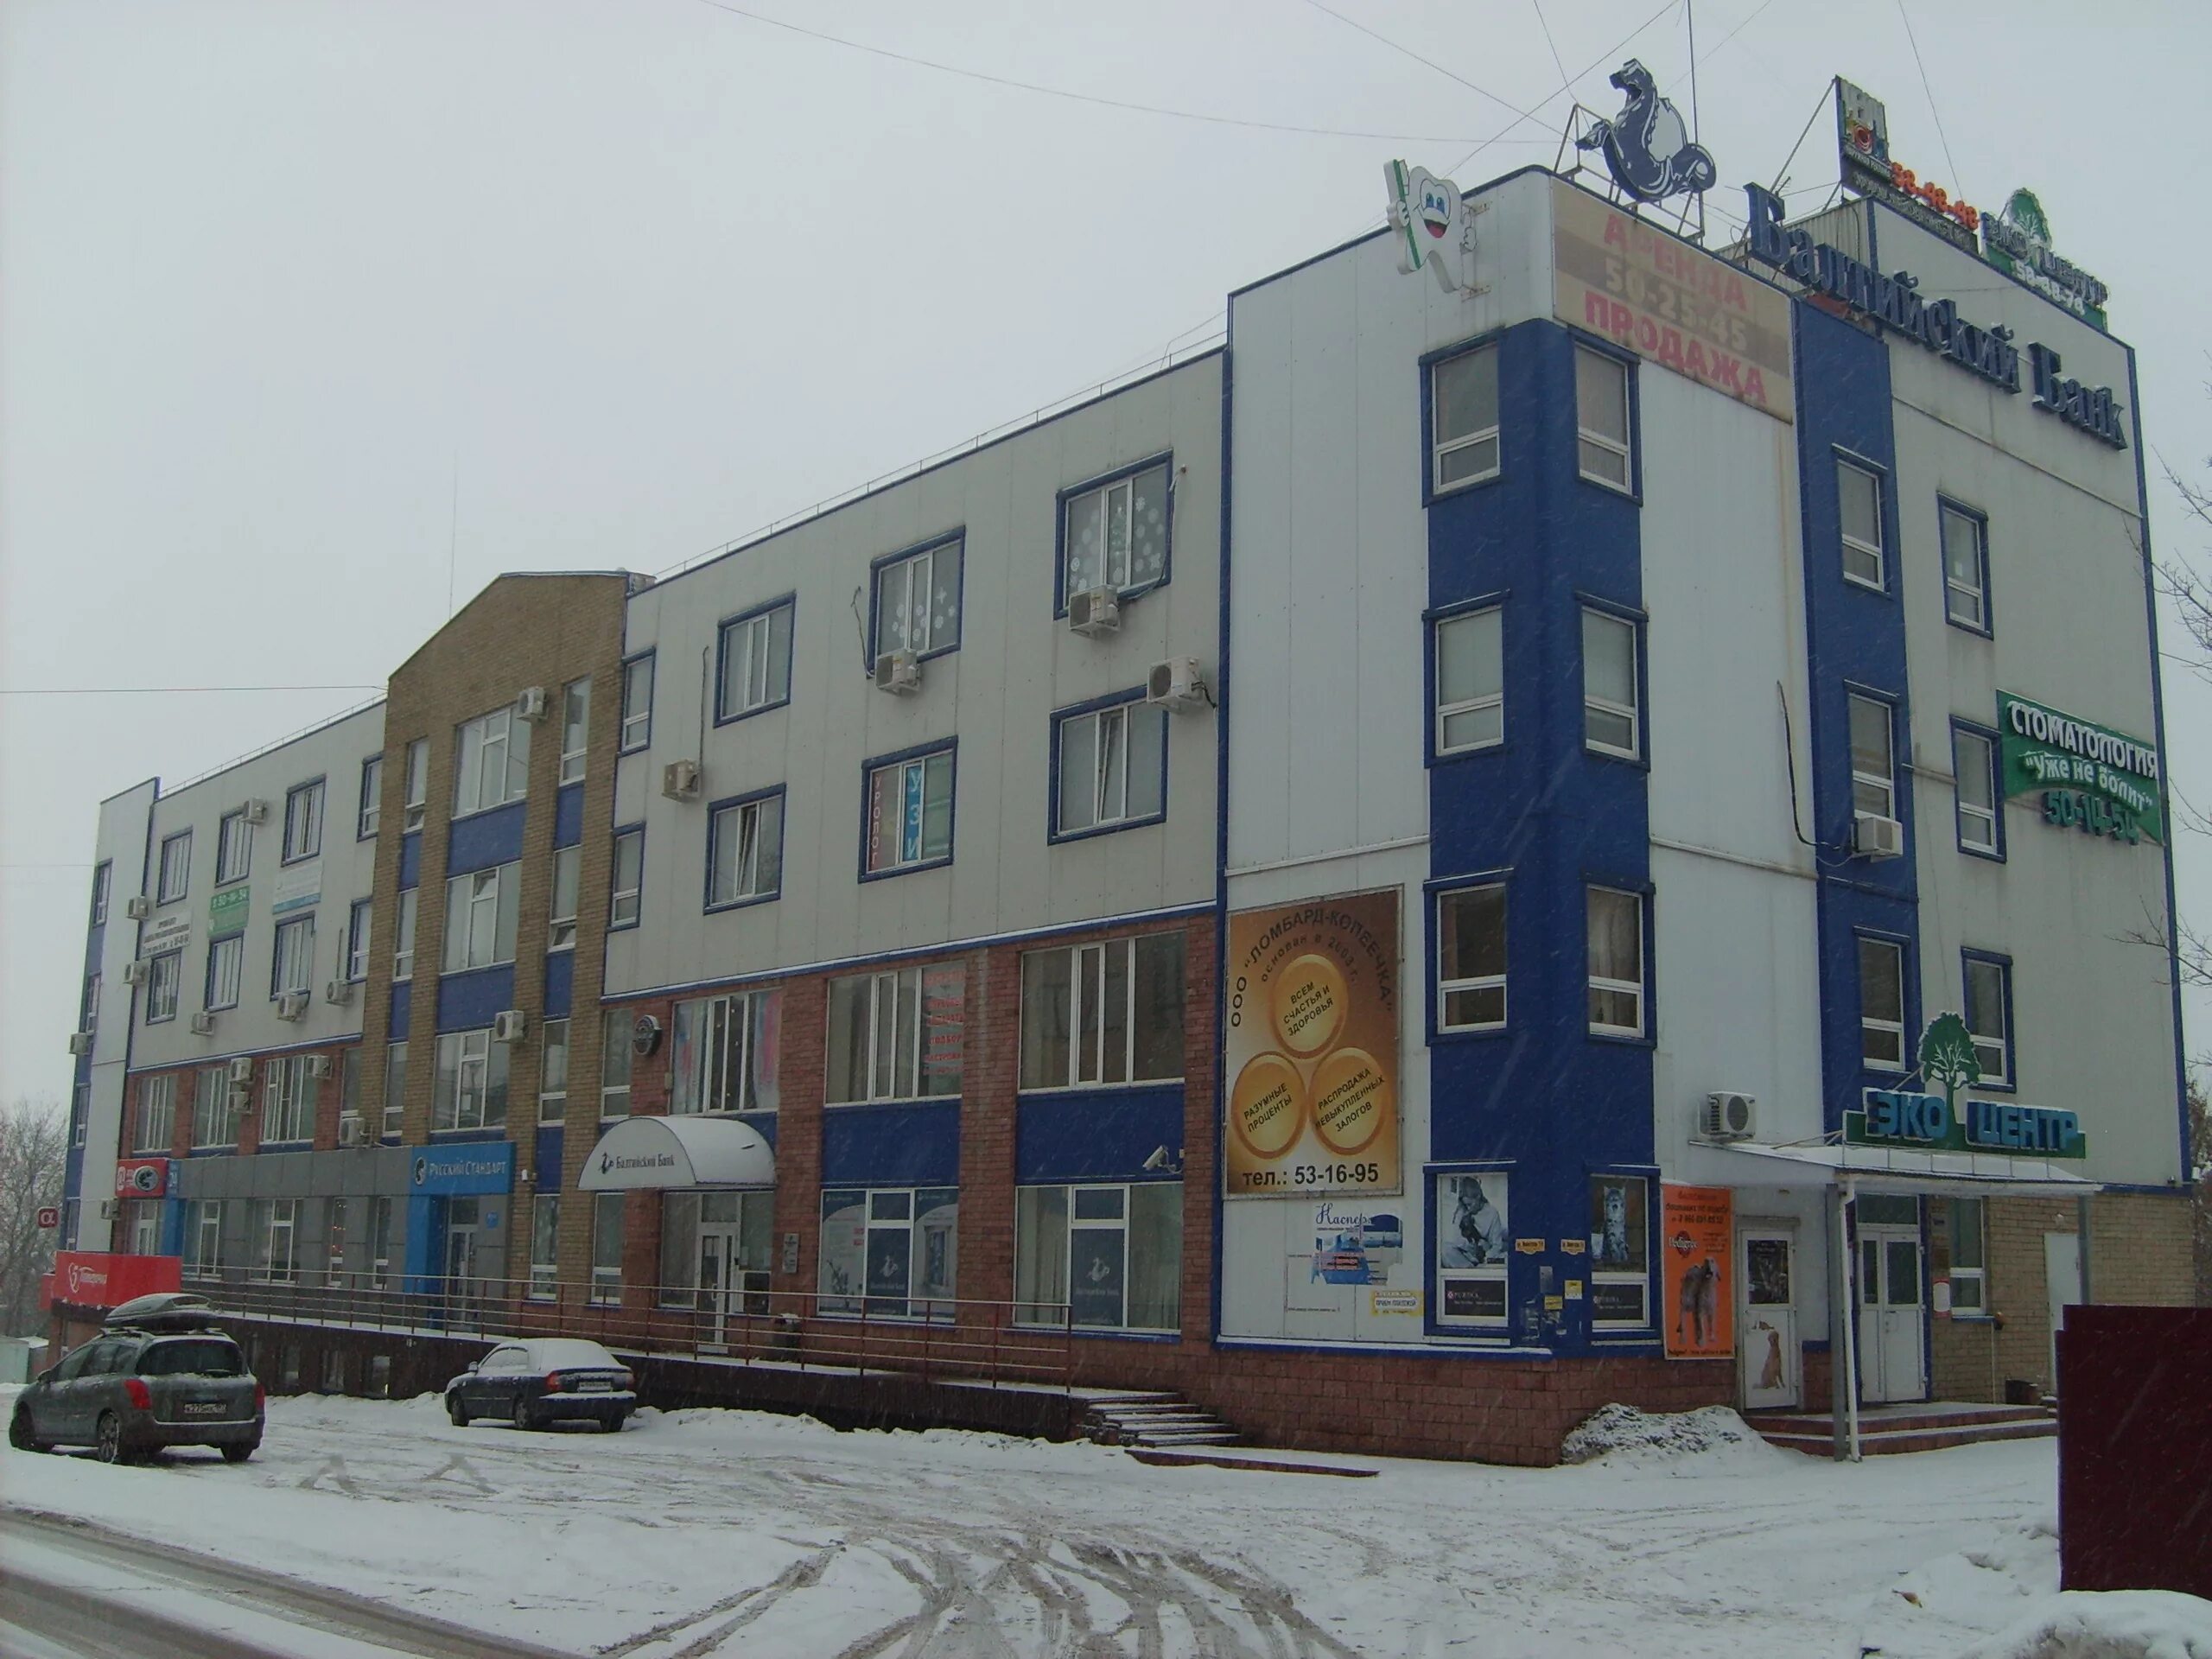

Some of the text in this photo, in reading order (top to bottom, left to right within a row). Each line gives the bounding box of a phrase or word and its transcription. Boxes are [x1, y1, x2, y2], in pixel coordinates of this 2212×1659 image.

[1743, 182, 2021, 394] Балтийский
[2029, 342, 2127, 450] Банк
[1585, 291, 1766, 404] ПРОДАЖА
[2008, 701, 2159, 779] СТОМАТОЛОГИЯ
[2073, 759, 2094, 783] не
[2044, 791, 2139, 845] 50-14-54
[1261, 936, 1307, 982] основан
[1283, 989, 1322, 1026] СЧАСТЬЯ
[1290, 982, 1315, 1005] ВСЕМ
[1287, 997, 1334, 1036] ЗДОРОВЬЯ
[1243, 1083, 1288, 1121] РАЗУМНЫЕ
[1318, 1068, 1371, 1110] РАСПРОДАЖА
[1248, 1096, 1293, 1133] ПРОЦЕНТЫ
[1335, 1101, 1372, 1132] ЗАЛОГОВ
[1866, 1089, 2079, 1152] ЭКО ЦЕНТР
[1243, 1163, 1380, 1187] тел.: 53-16-95
